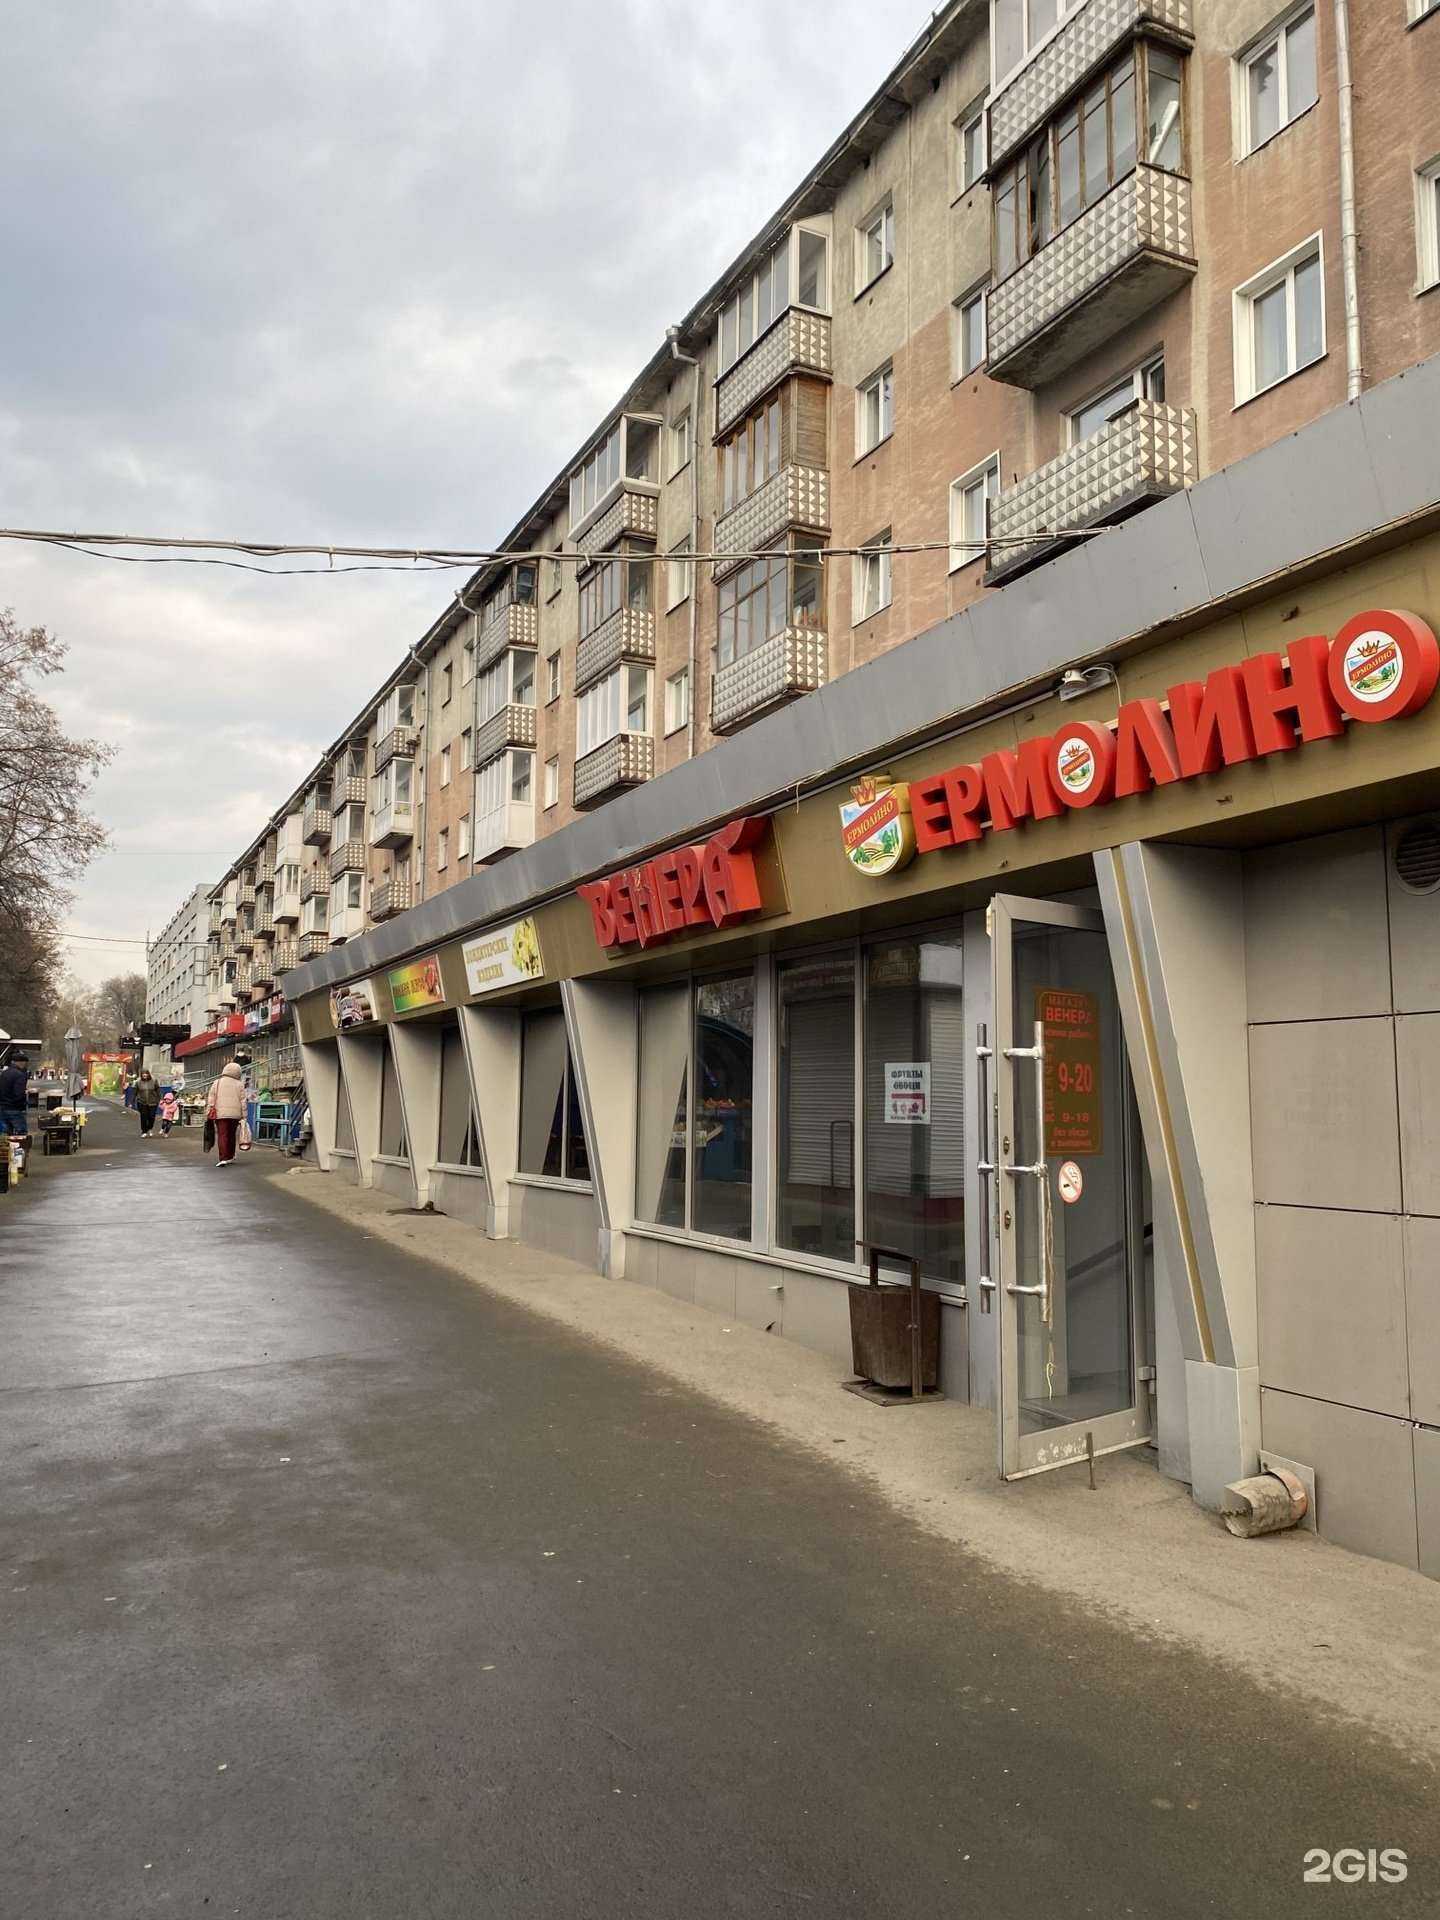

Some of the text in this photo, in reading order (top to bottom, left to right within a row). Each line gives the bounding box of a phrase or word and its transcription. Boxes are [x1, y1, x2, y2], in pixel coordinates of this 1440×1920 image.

[908, 608, 1438, 855] ЕРМОЛИНО
[846, 799, 894, 845] ЕРМОЛИНО
[576, 817, 762, 949] ВЕНЕРА
[1059, 1062, 1092, 1093] 9-20
